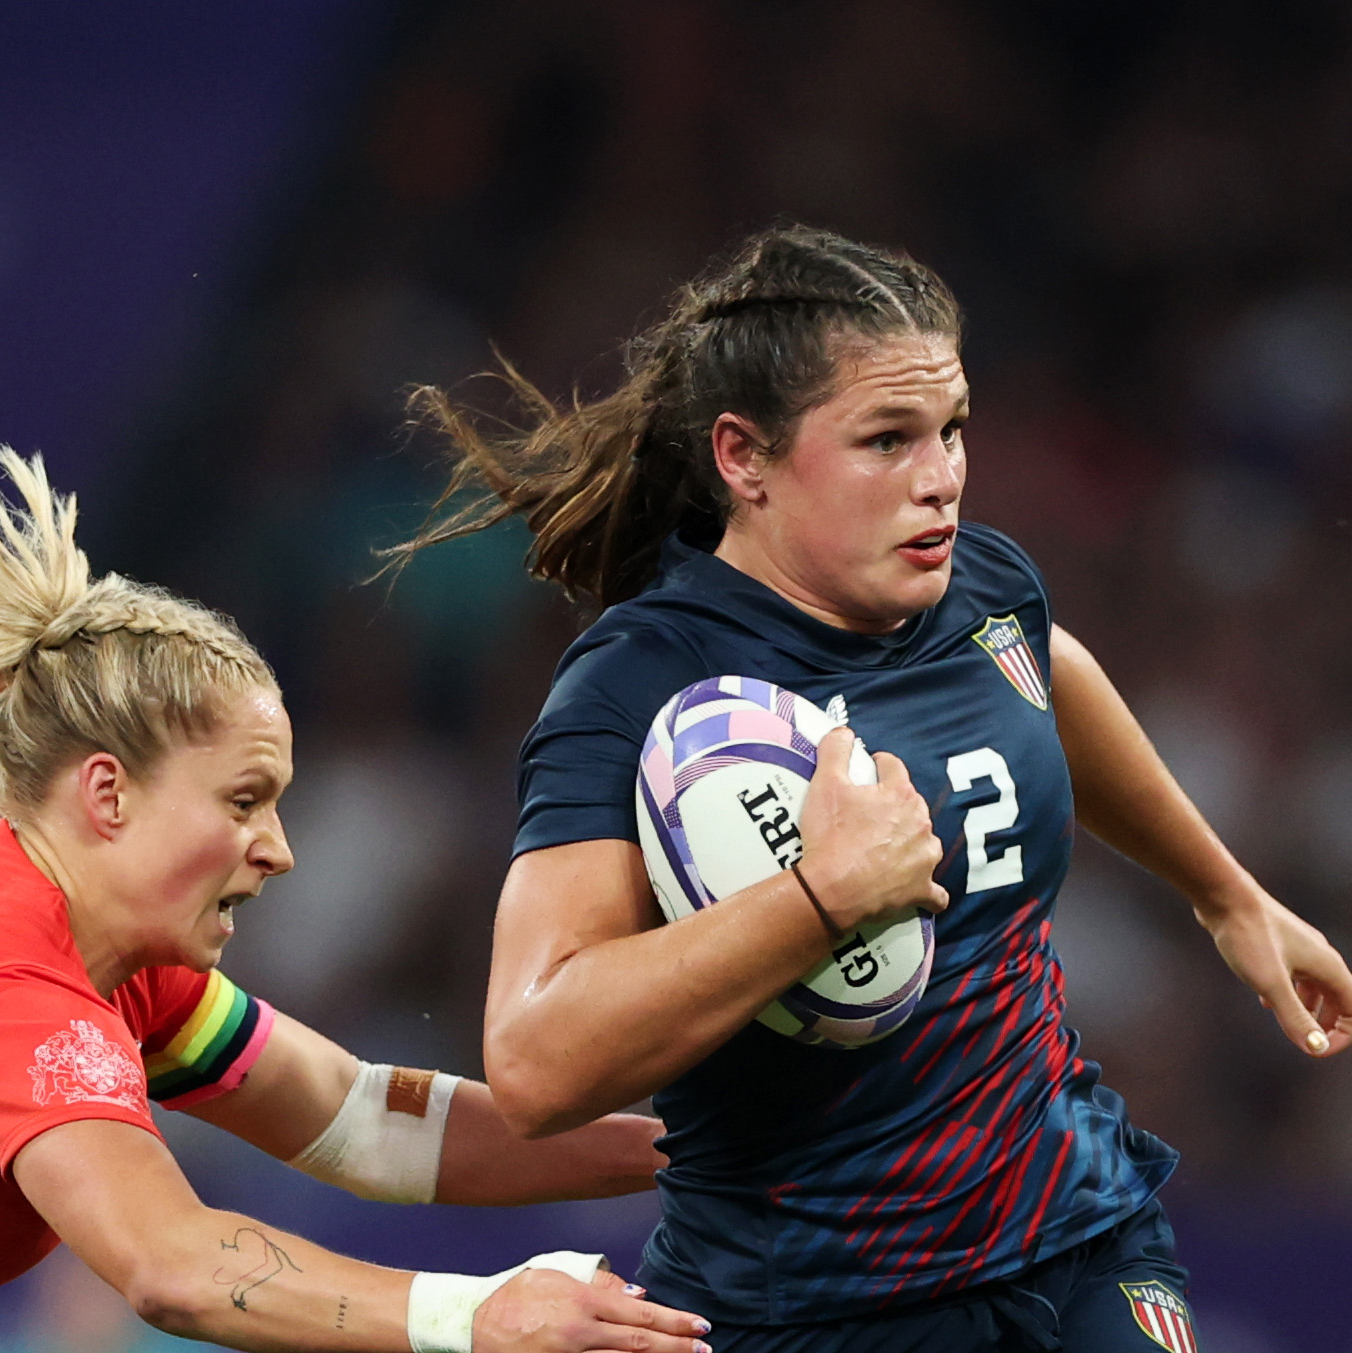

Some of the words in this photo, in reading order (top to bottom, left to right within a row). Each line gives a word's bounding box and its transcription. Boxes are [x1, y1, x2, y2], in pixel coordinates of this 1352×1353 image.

[988, 625, 1015, 649] USA
[946, 747, 1024, 894] 2
[737, 783, 878, 987] GIERT
[1141, 1286, 1178, 1313] USA
